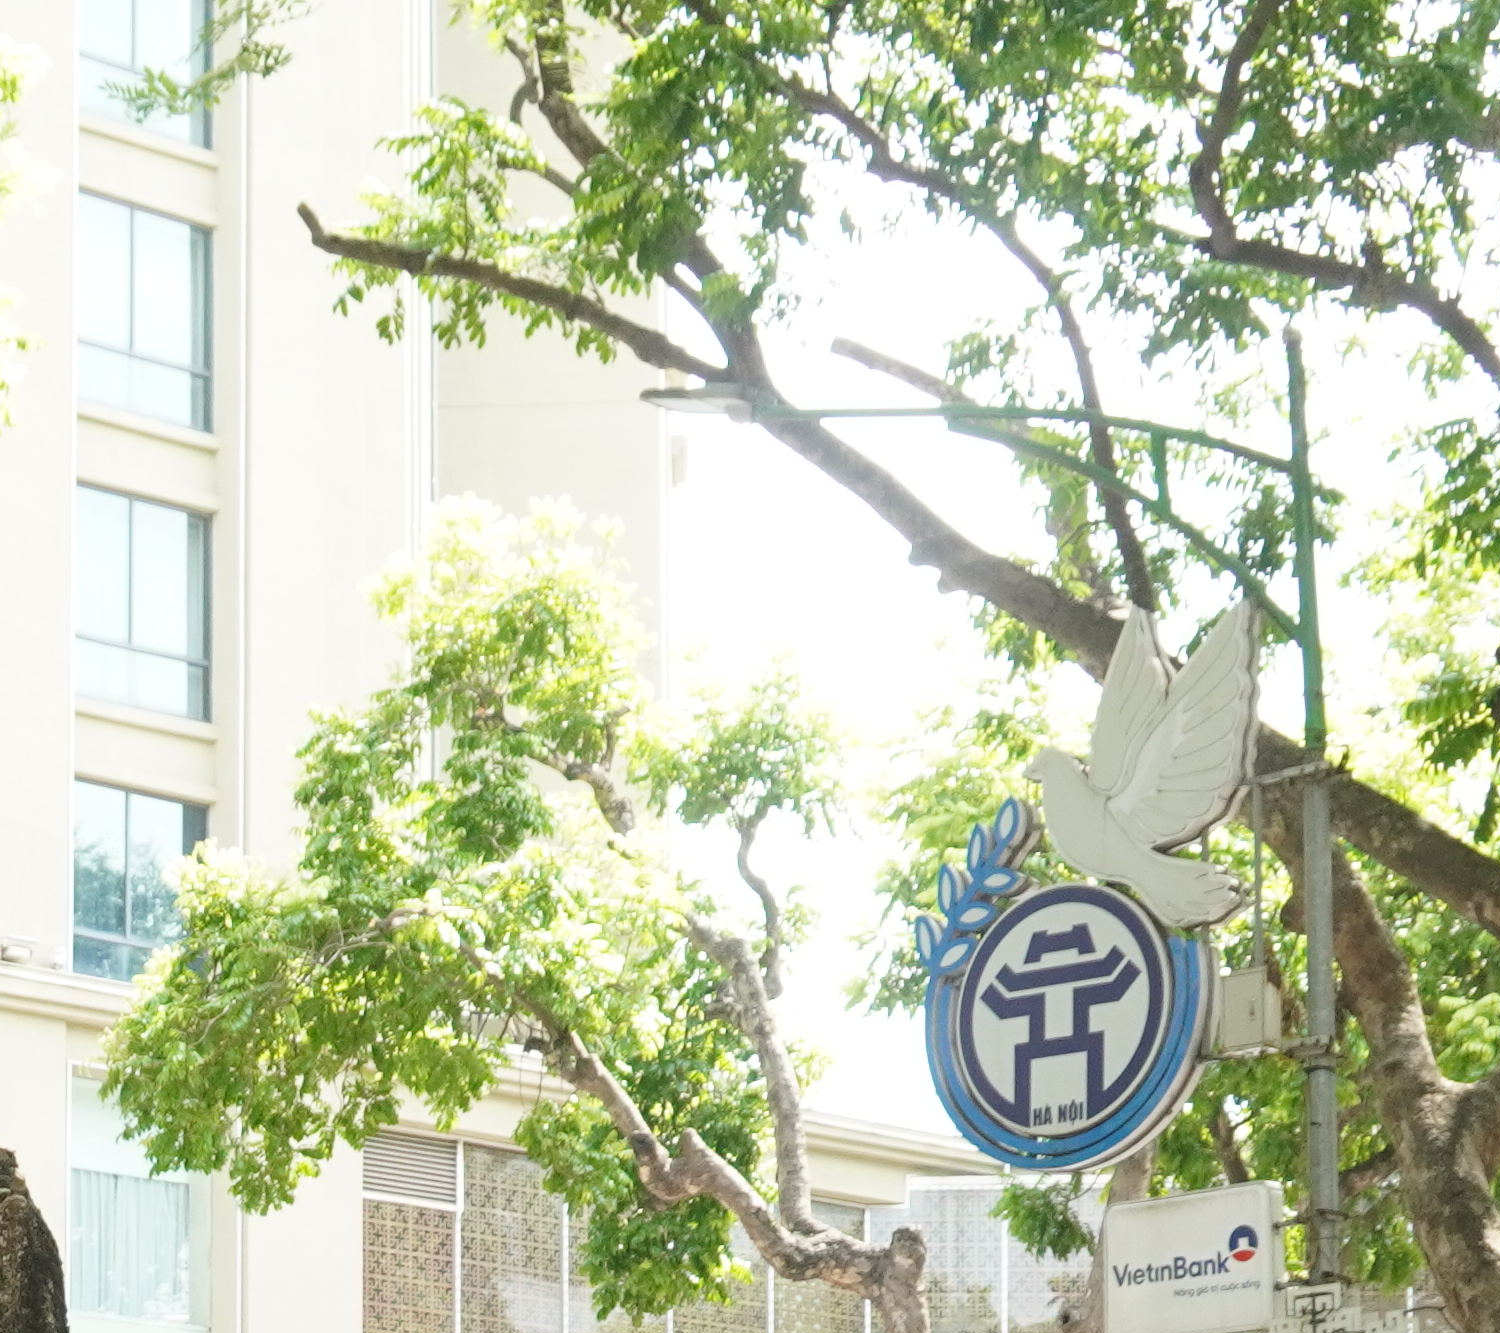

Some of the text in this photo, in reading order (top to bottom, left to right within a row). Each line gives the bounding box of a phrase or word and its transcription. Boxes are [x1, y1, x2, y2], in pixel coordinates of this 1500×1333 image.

[1033, 1099, 1084, 1127] HÀ NỘI
[1112, 1251, 1230, 1288] VietinBank
